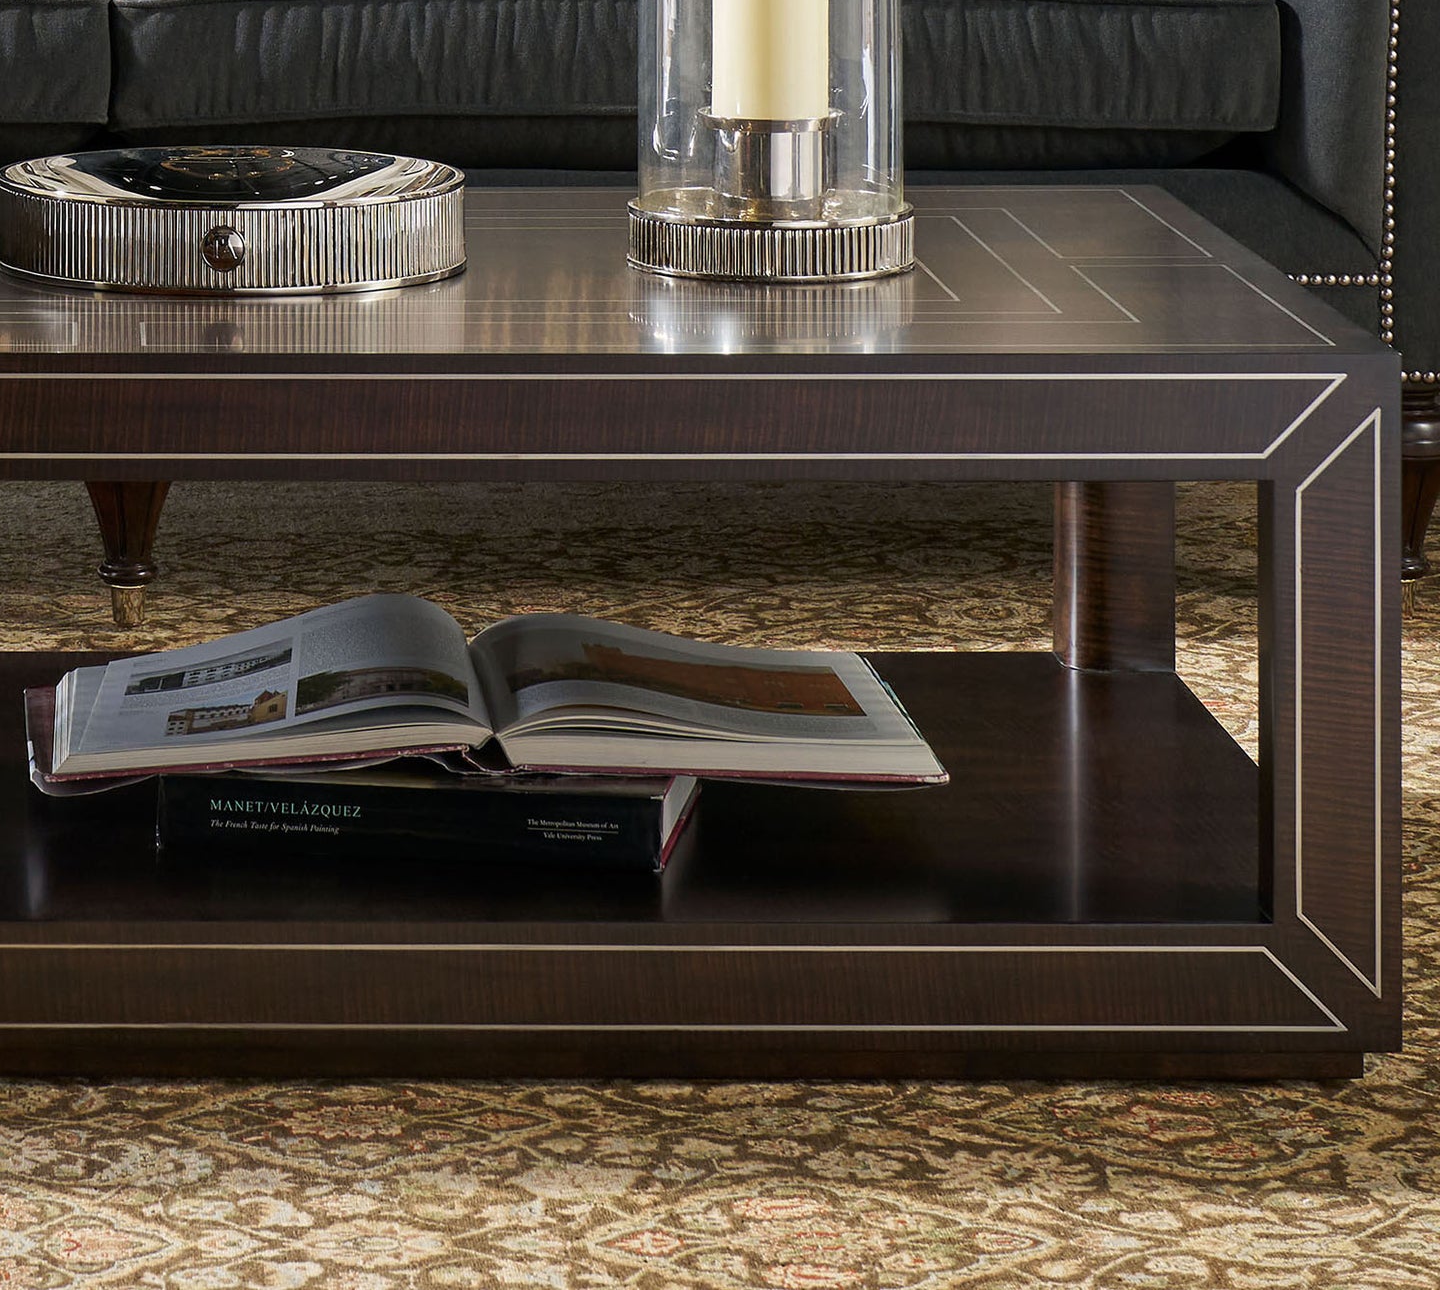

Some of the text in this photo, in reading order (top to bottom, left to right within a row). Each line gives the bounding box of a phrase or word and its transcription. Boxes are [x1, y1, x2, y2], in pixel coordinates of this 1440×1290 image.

[210, 799, 362, 819] MANET/VELÁZQUEZ
[210, 819, 340, 835] The French Taste for Spanish Painting
[540, 819, 576, 828] Metropolitan
[576, 821, 600, 829] Museum
[557, 832, 586, 841] University
